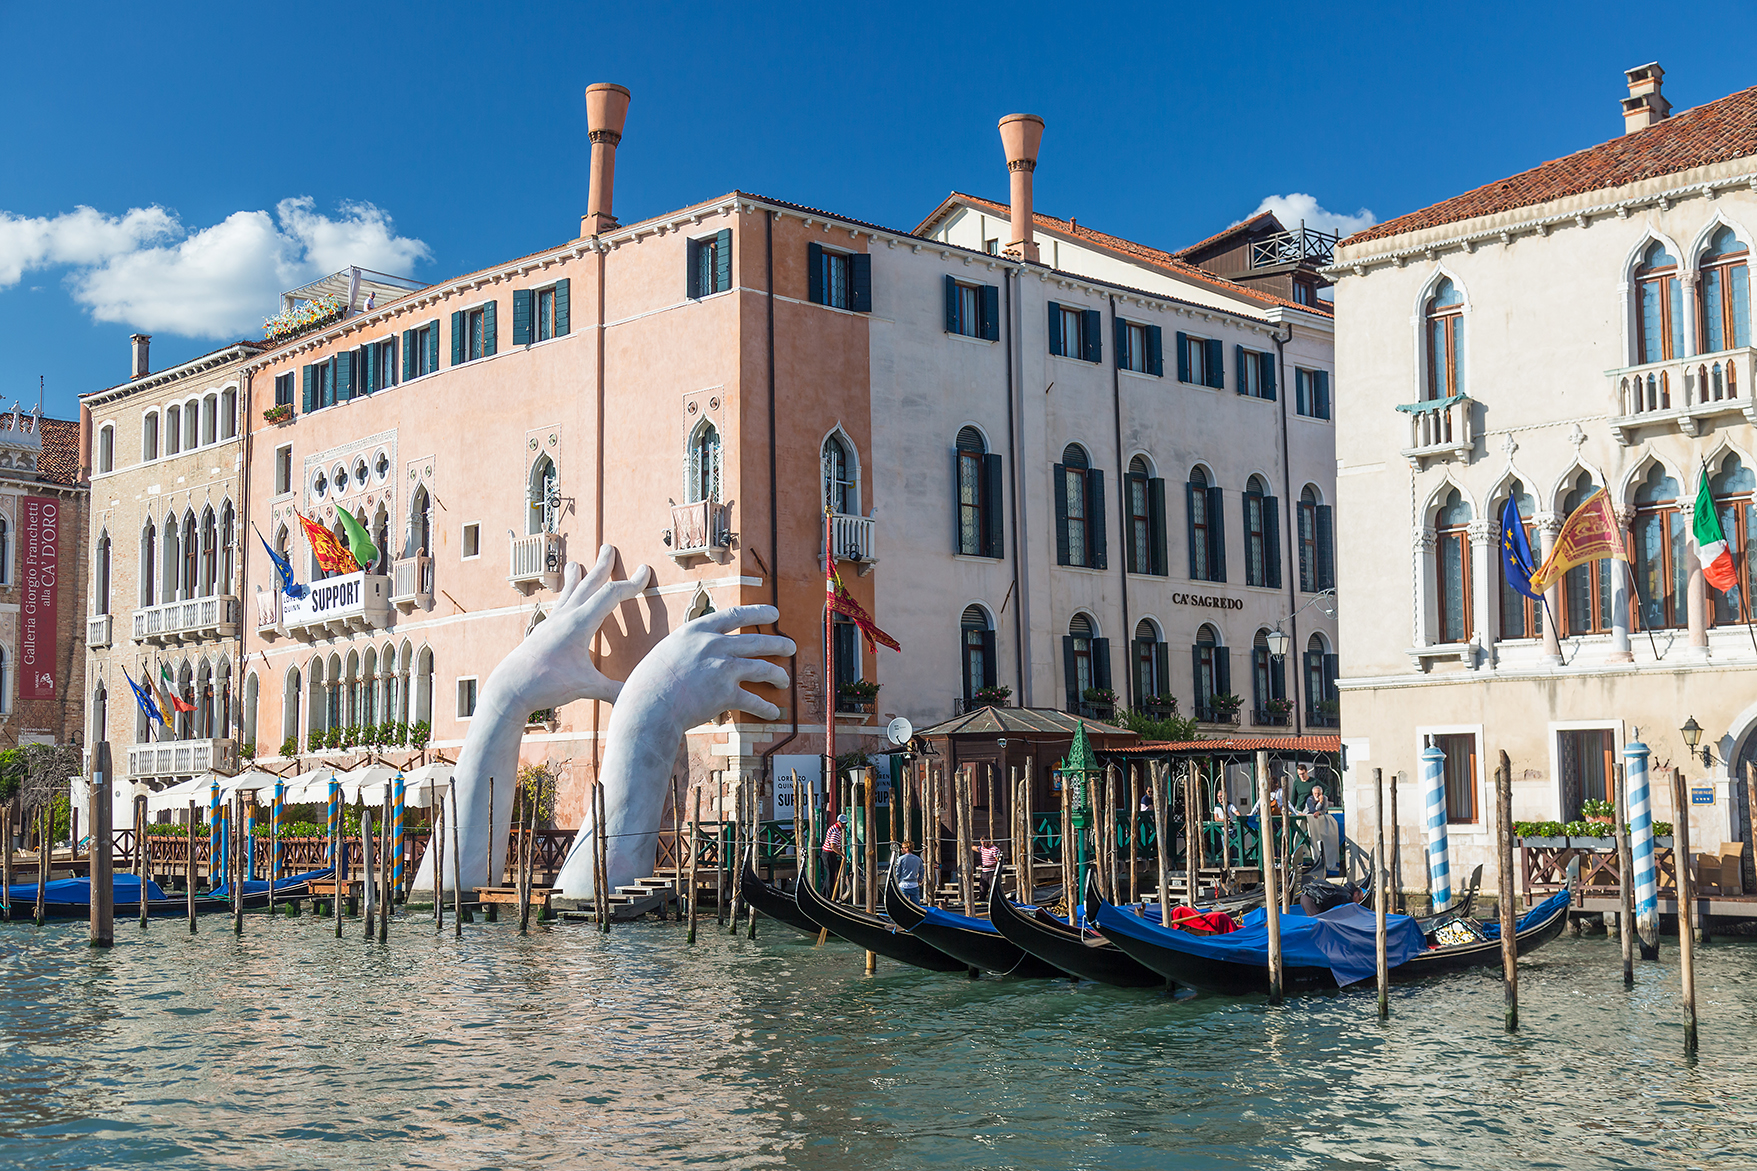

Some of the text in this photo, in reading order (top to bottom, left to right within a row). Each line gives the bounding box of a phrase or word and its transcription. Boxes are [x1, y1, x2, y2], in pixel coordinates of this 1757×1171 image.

[24, 502, 40, 665] Galleria Giorgio Franchetti
[41, 503, 57, 607] alla CA' D'ORO
[311, 579, 361, 613] SUPPORT
[1172, 592, 1244, 611] CA' SAGREDO
